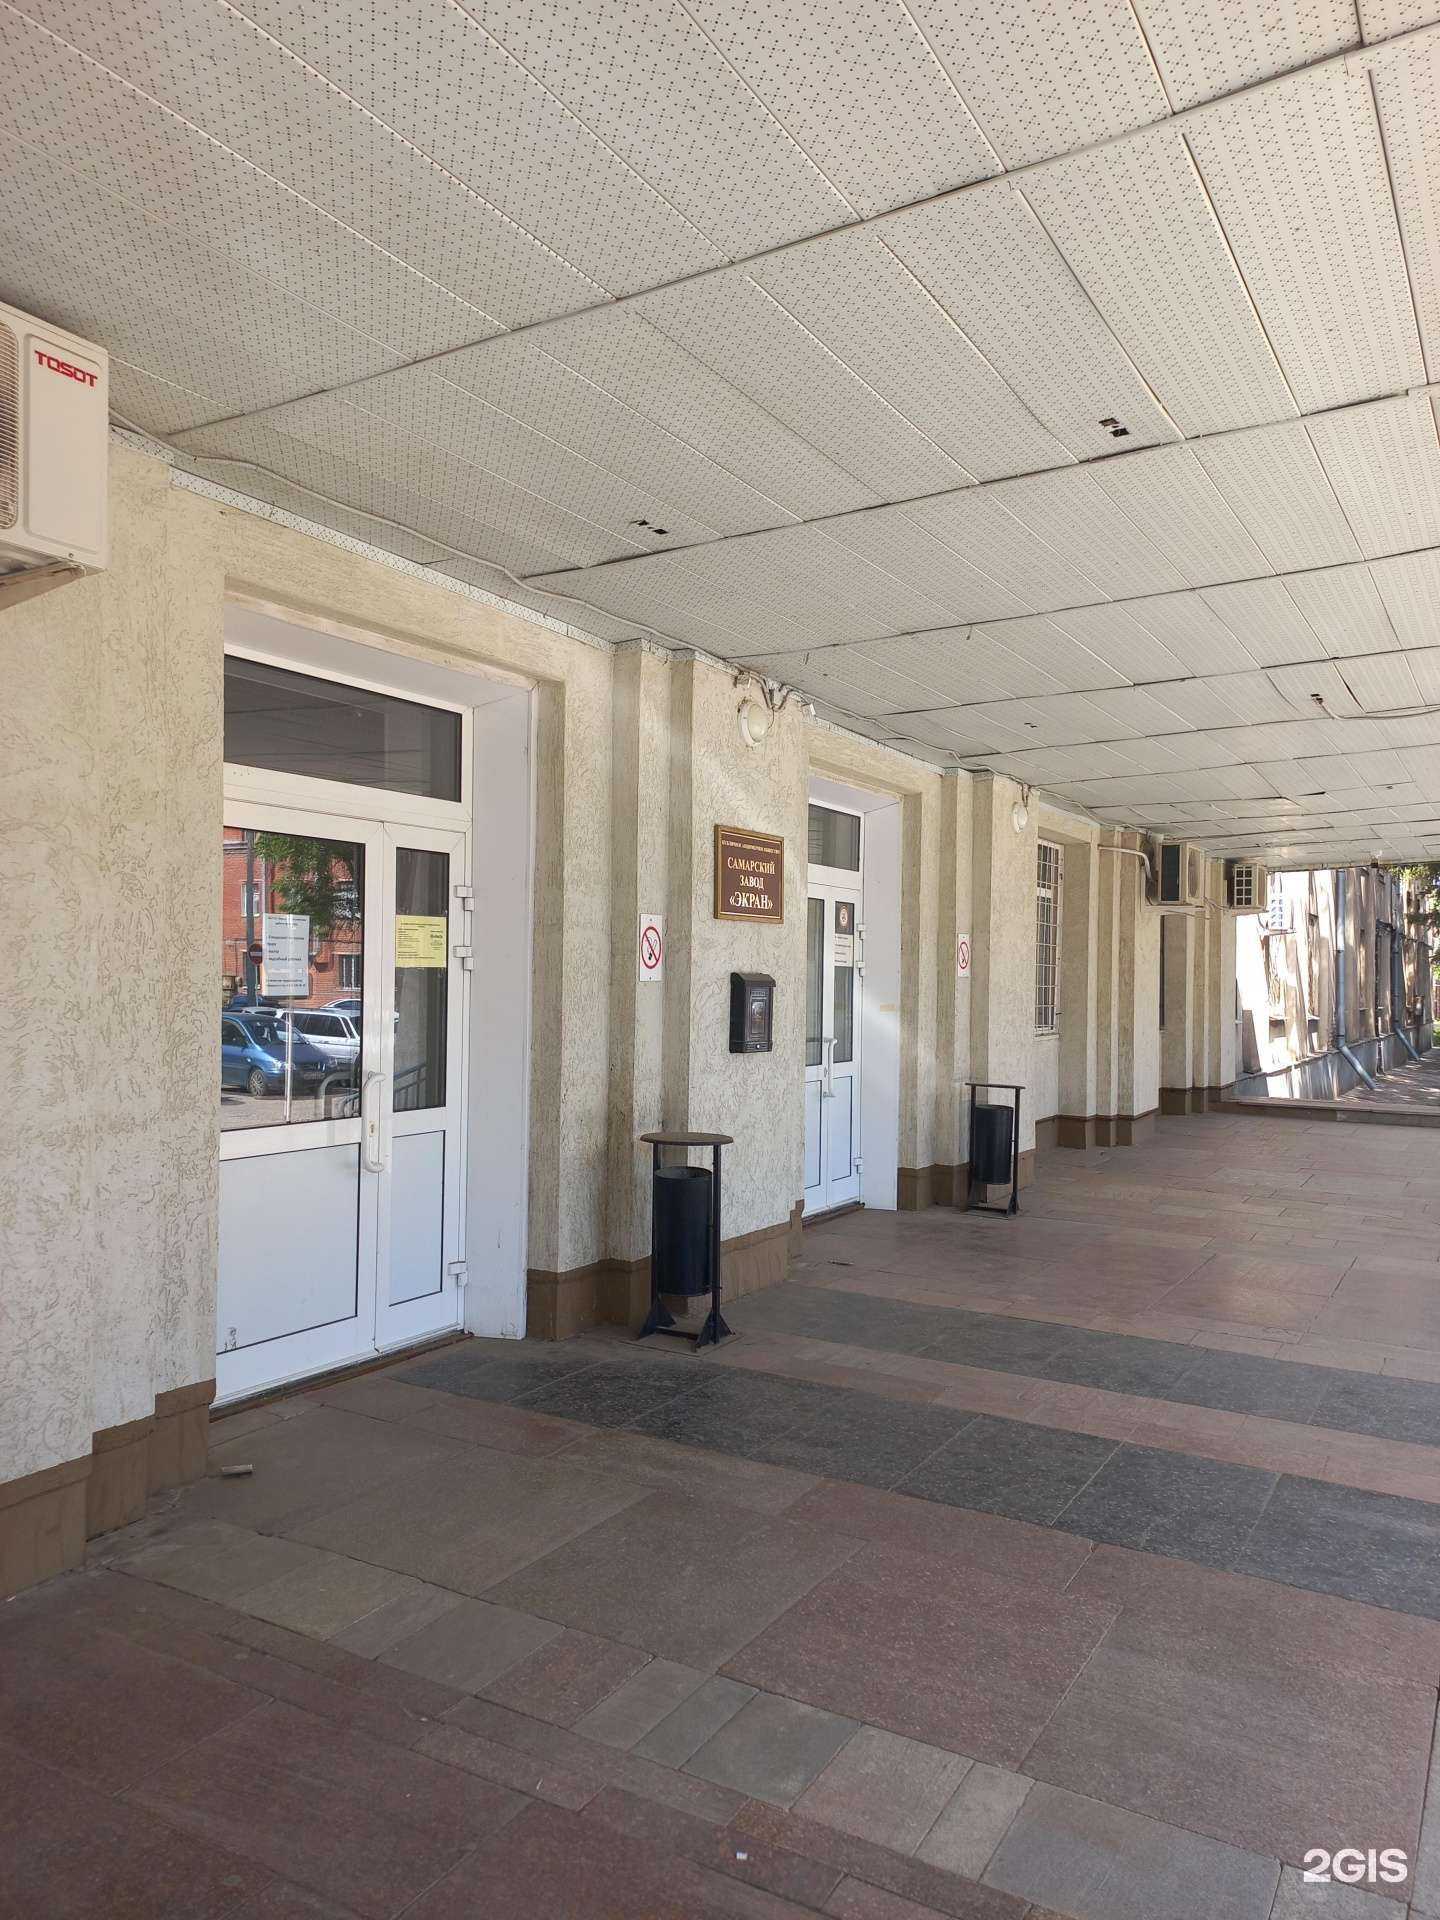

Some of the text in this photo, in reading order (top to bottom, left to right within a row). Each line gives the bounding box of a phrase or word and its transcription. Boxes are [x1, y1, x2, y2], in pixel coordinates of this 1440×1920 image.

[34, 350, 98, 387] TOSOT
[727, 856, 776, 875] САМАРСКИЙ
[739, 875, 765, 889] ЗАВОД
[729, 891, 773, 909] «ЭКРАН»
